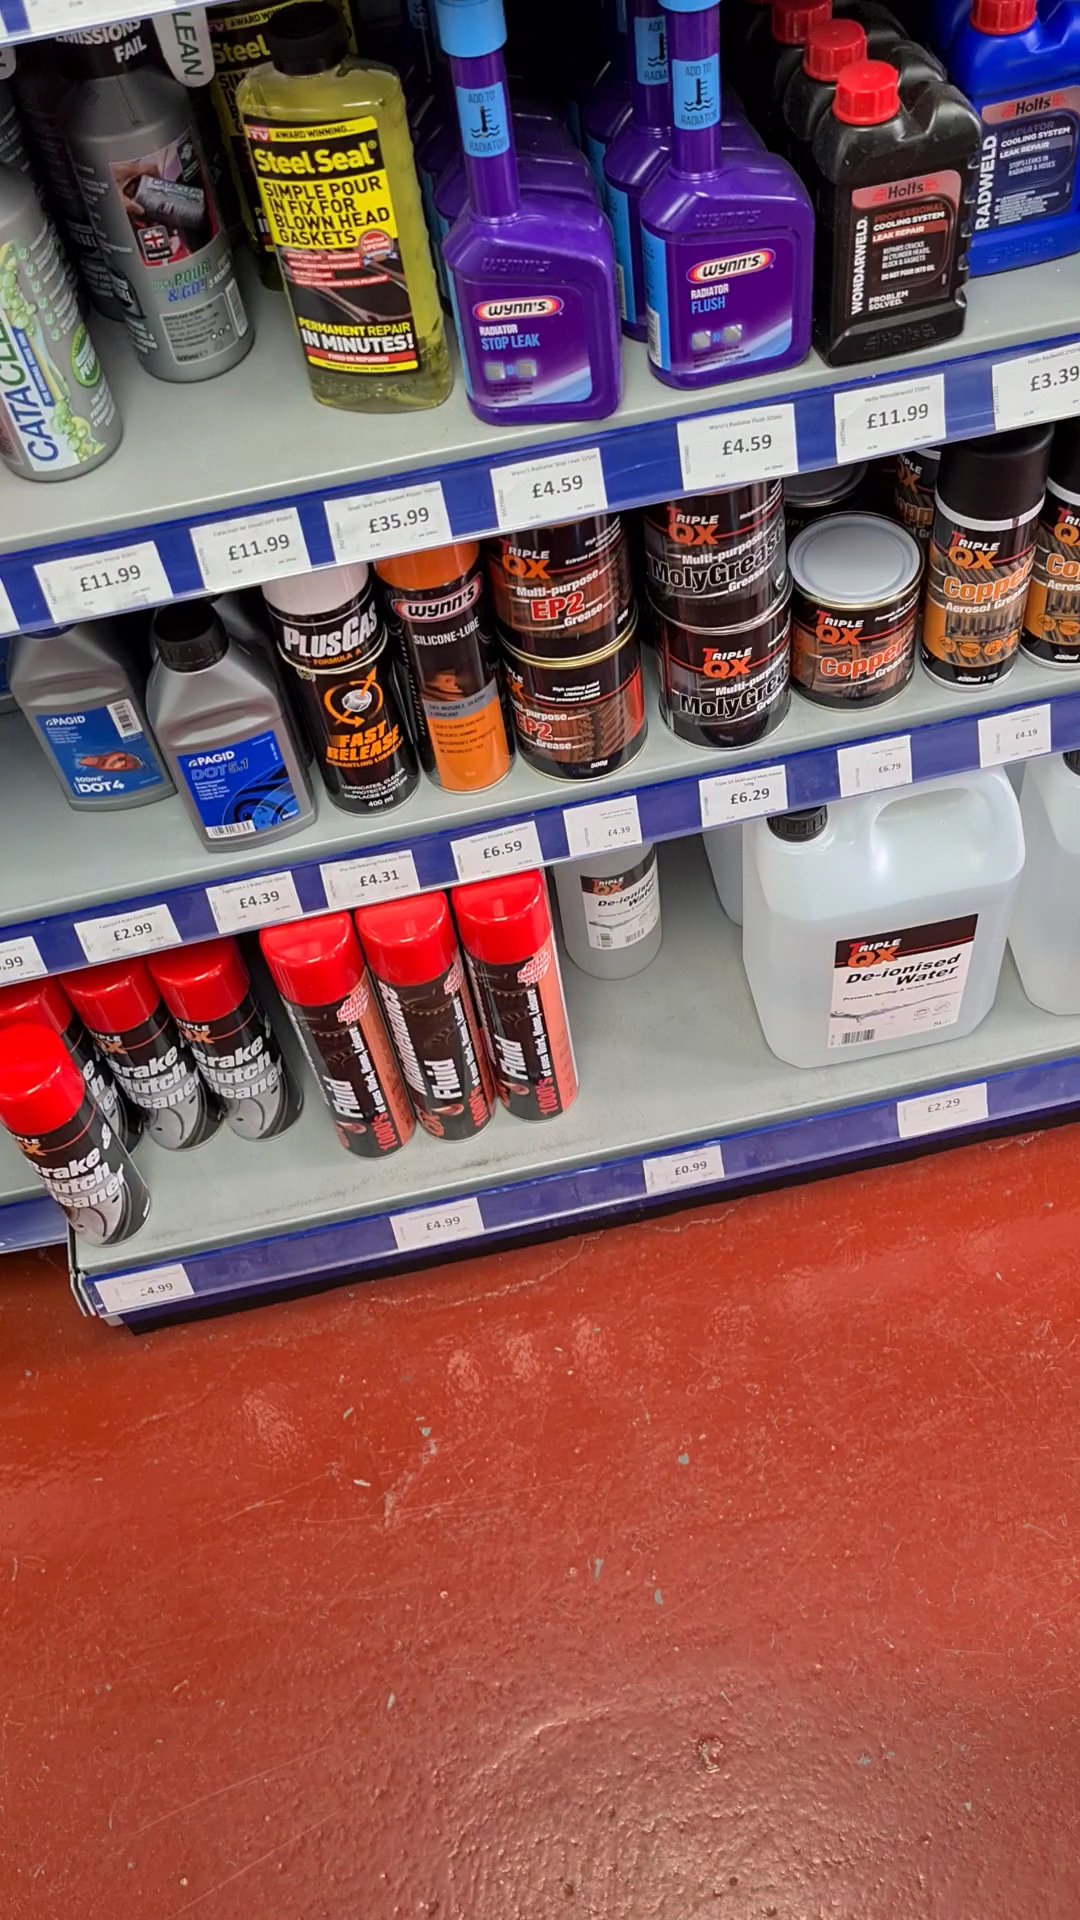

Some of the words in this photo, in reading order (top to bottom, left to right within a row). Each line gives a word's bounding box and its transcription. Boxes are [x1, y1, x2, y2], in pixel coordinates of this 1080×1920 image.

[648, 21, 663, 32] ADD
[113, 37, 147, 63] FAIL
[685, 65, 700, 77] ADD
[703, 62, 712, 73] TO
[468, 94, 484, 104] ADD
[486, 91, 496, 101] TO
[1016, 97, 1051, 116] Holts
[681, 109, 718, 126] RADIATOR
[275, 129, 304, 139] AWARD
[1001, 133, 1037, 148] COOLING
[1038, 126, 1071, 139] SYSTEM
[469, 139, 507, 152] RADIATOR
[1000, 147, 1020, 159] LEAK
[1021, 141, 1050, 153] REPAIR
[254, 148, 314, 174] Steel
[315, 142, 374, 173] Seal
[1009, 160, 1025, 170] STOPS
[1025, 157, 1041, 167] LEAKS
[1008, 165, 1033, 177] RADIATOR
[1038, 160, 1056, 169] HOSES
[263, 182, 326, 200] SIMPLE
[330, 176, 381, 195] POUR
[888, 181, 925, 200] Holts
[974, 134, 998, 230] RADWELD
[269, 198, 284, 213] IN
[290, 200, 314, 215] FIX
[320, 198, 356, 214] FOR
[274, 214, 334, 230] BLOWN
[340, 207, 389, 228] HEAD
[873, 217, 911, 232] COOLING
[912, 211, 945, 224] SYSTEM
[279, 230, 356, 247] GASKETS
[872, 231, 894, 243] LEAK
[895, 226, 925, 238] REPAIR
[883, 244, 904, 254] REPAIRS
[905, 241, 925, 250] CRACKS
[889, 250, 912, 260] CYLINDER
[174, 258, 211, 286] POUR
[703, 254, 761, 278] wynn's
[882, 259, 898, 269] BLOCK
[903, 255, 926, 265] GASKETS
[890, 271, 900, 279] NOT
[900, 268, 914, 277] POUR
[168, 287, 178, 303] &
[691, 283, 729, 300] RADIATOR
[869, 290, 909, 304] PROBLEM
[488, 301, 547, 317] wynn's
[692, 296, 726, 314] FLUSH
[868, 299, 904, 312] SOLVED.
[299, 317, 365, 336] PERMANENT
[367, 322, 411, 336] REPAIR
[479, 324, 518, 337] RADIATOR
[301, 330, 319, 347] IN
[323, 335, 414, 353] MINUTES!
[481, 337, 509, 351] STOP
[512, 334, 541, 348] LEAK
[1030, 365, 1080, 392] £3.39
[867, 403, 929, 429] £11.99
[722, 434, 772, 455] £4.59
[532, 475, 583, 498] £4.59
[369, 507, 430, 534] £35.99
[668, 505, 719, 525] TRIPLE
[668, 523, 718, 547] QX
[951, 531, 1001, 552] TRIPLE
[228, 534, 290, 561] £11.99
[499, 537, 550, 560] TRIPLE
[652, 518, 785, 593] MolyGrease
[681, 531, 764, 565] Multi-purpose
[502, 553, 551, 580] QX
[949, 546, 997, 571] QX
[80, 564, 141, 592] £11.99
[516, 569, 599, 597] Multi-purpose
[727, 565, 767, 593] Grease
[943, 557, 1034, 605] Copper
[408, 585, 475, 617] wynn's
[531, 591, 585, 621] EP2
[945, 602, 991, 614] Aerosol
[564, 603, 603, 627] Grease
[816, 610, 865, 628] TRIPLE
[413, 616, 480, 646] SILICONE-LUBE
[815, 624, 863, 646] QX
[313, 653, 352, 665] FORMULA
[702, 647, 753, 662] TRIPLE
[820, 635, 907, 679] Copper
[702, 655, 752, 679] QX
[875, 651, 909, 679] Grease
[52, 715, 86, 727] PAGID
[516, 711, 553, 741] EP2
[327, 724, 399, 761] RELEASE
[339, 720, 387, 748] FAST
[1015, 728, 1038, 740] £4.19
[536, 739, 572, 750] Grease
[197, 750, 235, 766] PAGID
[590, 760, 608, 769] 500g
[191, 764, 227, 781] DOT
[228, 758, 248, 774] 5.1
[878, 763, 901, 774] £6.79
[79, 781, 112, 794] DOT
[344, 792, 380, 800] DISPLACES
[352, 785, 386, 795] PROTECTS
[388, 778, 400, 788] AND
[730, 788, 770, 805] £6.29
[367, 798, 384, 807] 400
[384, 795, 394, 805] ml
[607, 826, 631, 837] £4.39
[483, 840, 522, 859] £6.59
[360, 869, 400, 887] £4.31
[593, 883, 624, 896] QX
[240, 891, 280, 909] £4.39
[114, 922, 153, 942] £2.99
[849, 938, 901, 955] TRIPLE
[0, 956, 24, 971] .99
[847, 946, 900, 968] QX
[846, 953, 962, 984] De-ionised
[896, 965, 960, 986] Water
[527, 988, 540, 1015] Leisure
[532, 1012, 546, 1037] Home,
[349, 1025, 365, 1054] Leisure
[535, 1033, 548, 1056] Work,
[358, 1049, 373, 1074] Home,
[494, 1033, 528, 1080] Fluid
[540, 1054, 551, 1069] uses
[364, 1069, 380, 1093] Work,
[424, 1058, 463, 1099] Fluid
[322, 1075, 365, 1119] Fluid
[372, 1090, 386, 1107] uses
[535, 1076, 560, 1115] 1000's
[928, 1098, 961, 1114] £2.29
[371, 1112, 399, 1151] 1000's
[674, 1160, 709, 1176] £0.99
[426, 1216, 462, 1232] £4.99
